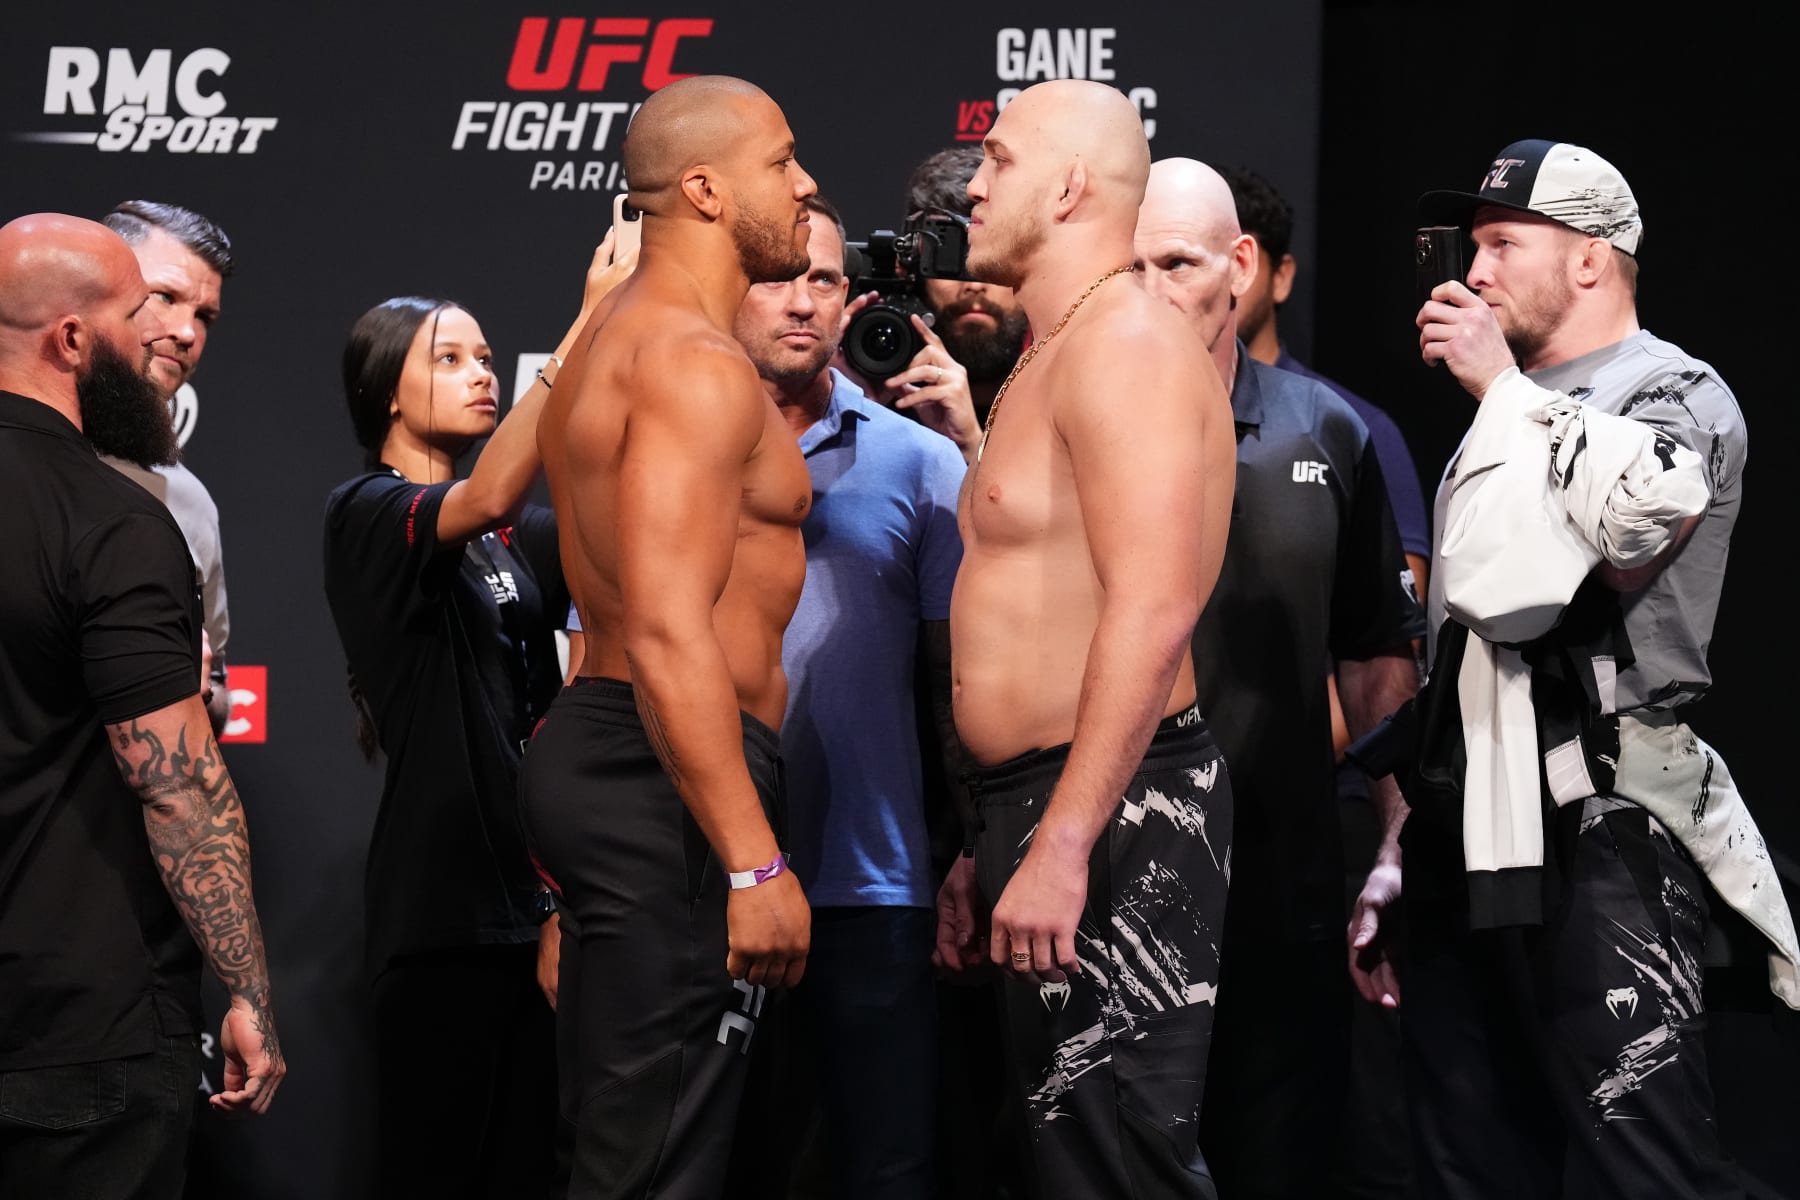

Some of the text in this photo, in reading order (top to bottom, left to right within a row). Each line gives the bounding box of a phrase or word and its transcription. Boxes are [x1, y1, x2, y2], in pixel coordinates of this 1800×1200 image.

[506, 17, 714, 92] UFC
[997, 28, 1116, 80] GANE
[44, 46, 231, 118] RMC
[96, 104, 278, 154] SPORT
[451, 101, 629, 151] FIGHT
[957, 101, 995, 133] VS
[1480, 158, 1526, 192] FC
[1292, 460, 1329, 486] UFC
[484, 573, 509, 604] UFC
[499, 571, 520, 602] UFC
[716, 978, 766, 1055] FC
